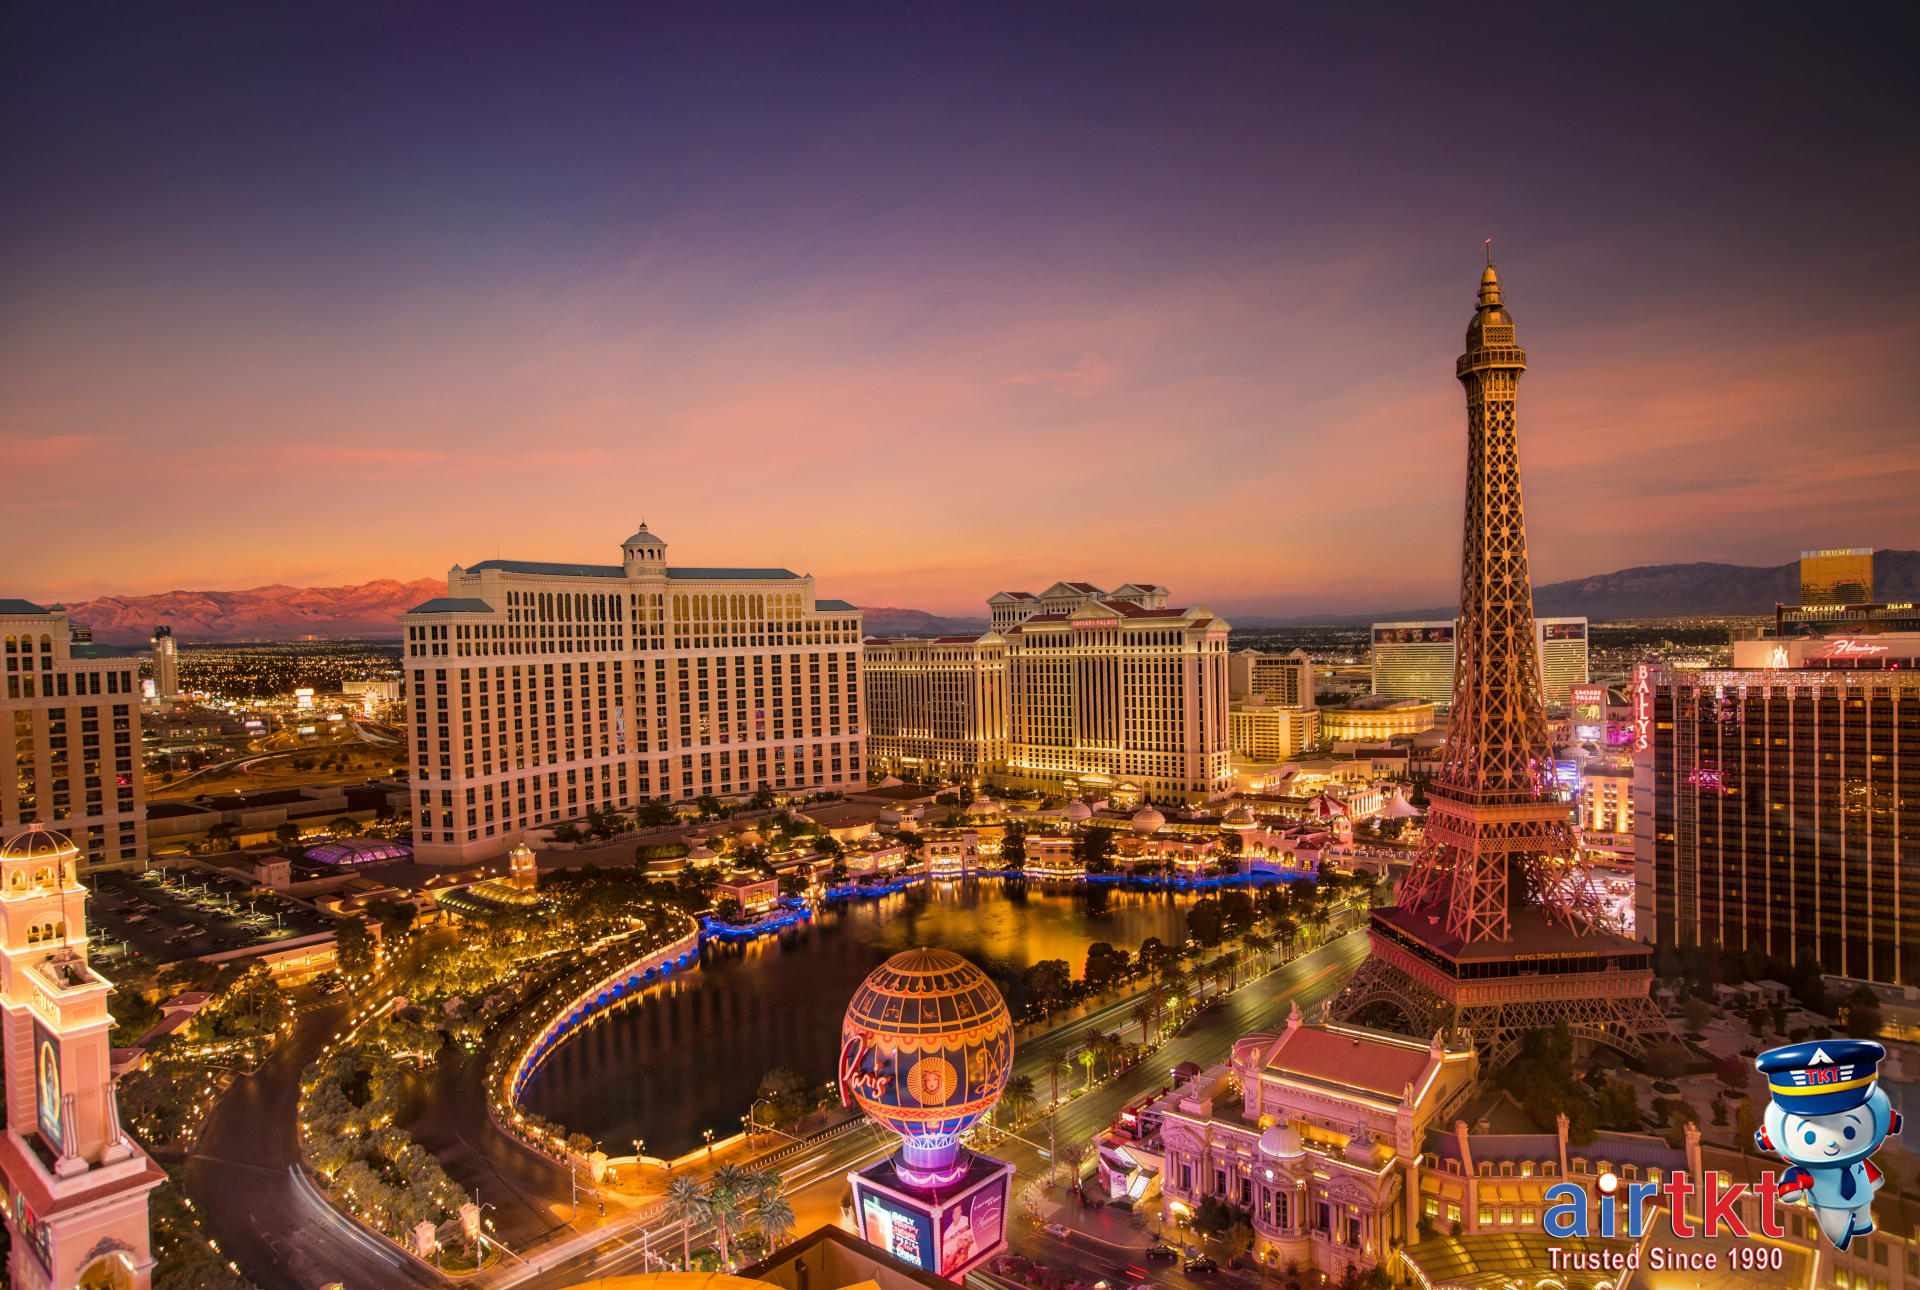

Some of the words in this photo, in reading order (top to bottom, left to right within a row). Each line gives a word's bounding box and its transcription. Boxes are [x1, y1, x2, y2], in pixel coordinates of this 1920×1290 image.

[1820, 549, 1852, 557] TRUMP
[1801, 605, 1847, 613] TREASURE
[1834, 640, 1889, 655] Flamingo
[1537, 952, 1559, 960] TOWER
[839, 1033, 889, 1107] Paris
